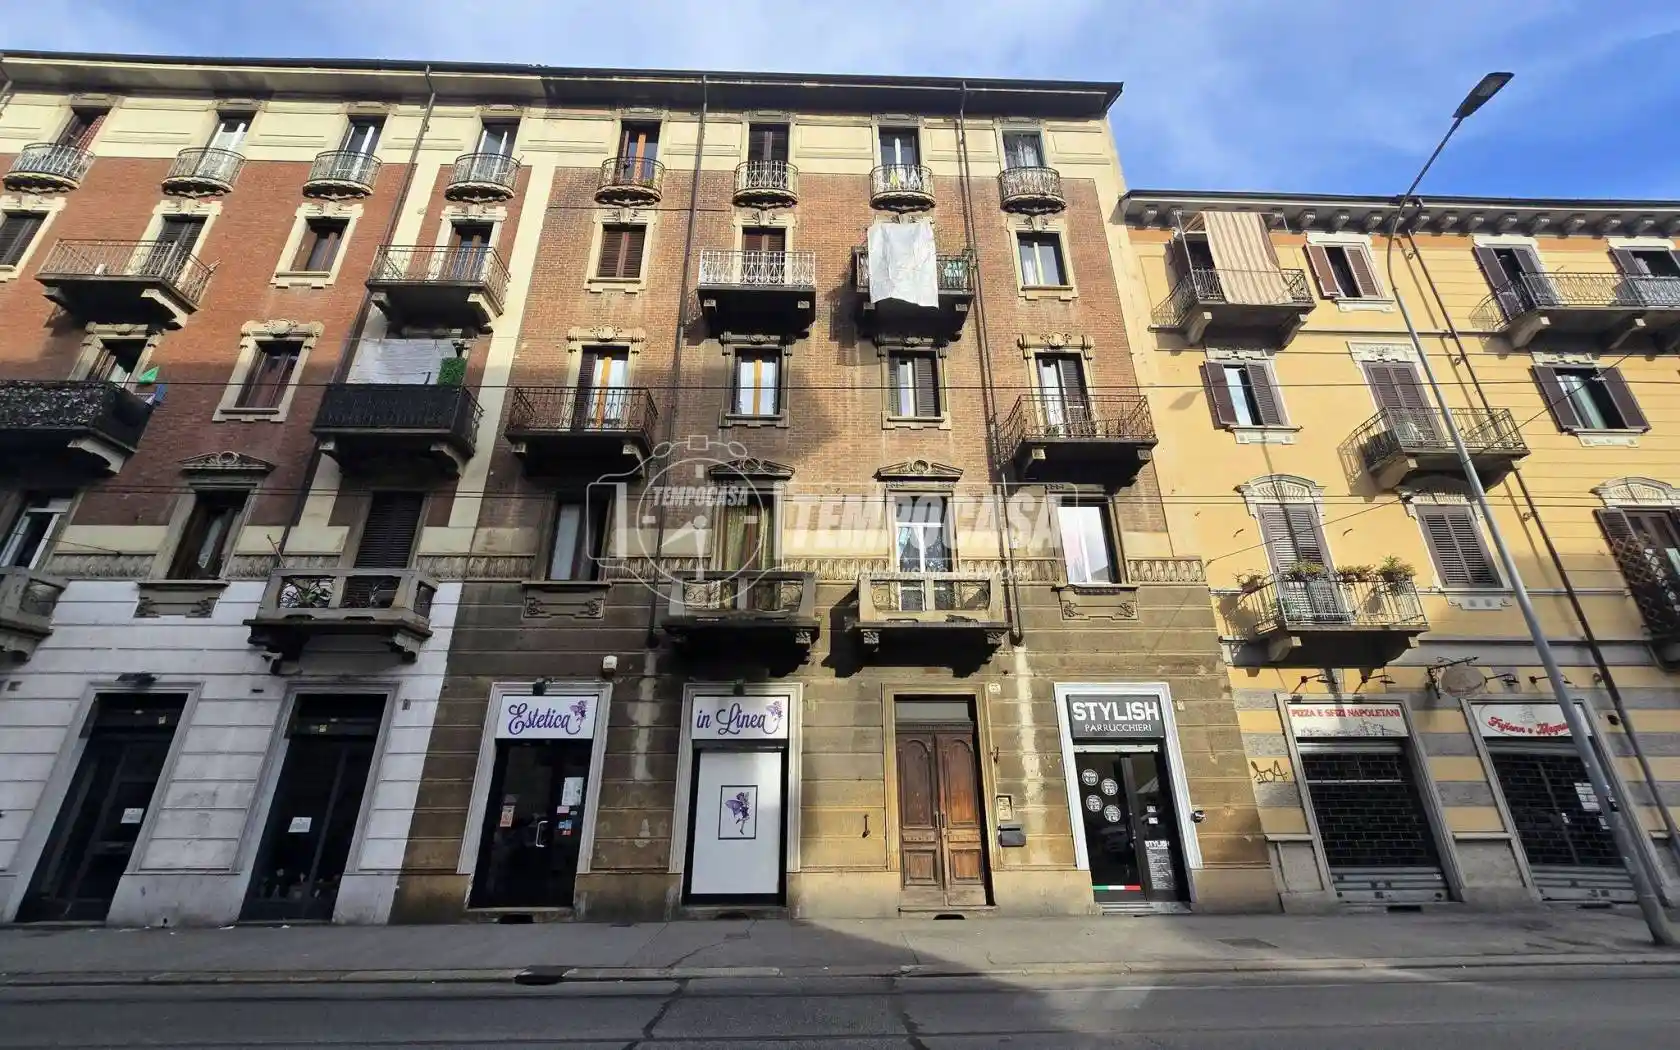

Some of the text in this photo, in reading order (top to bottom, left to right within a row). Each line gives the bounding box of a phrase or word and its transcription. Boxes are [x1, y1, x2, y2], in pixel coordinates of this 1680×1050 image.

[508, 703, 580, 735] Estetica
[696, 703, 778, 735] in Linea
[1072, 702, 1159, 720] STYLISH
[1291, 708, 1316, 717] PIZZA
[1318, 708, 1323, 717] E
[1347, 708, 1400, 717] NAPOLETANI
[1084, 724, 1151, 732] PARRUCCHIERI
